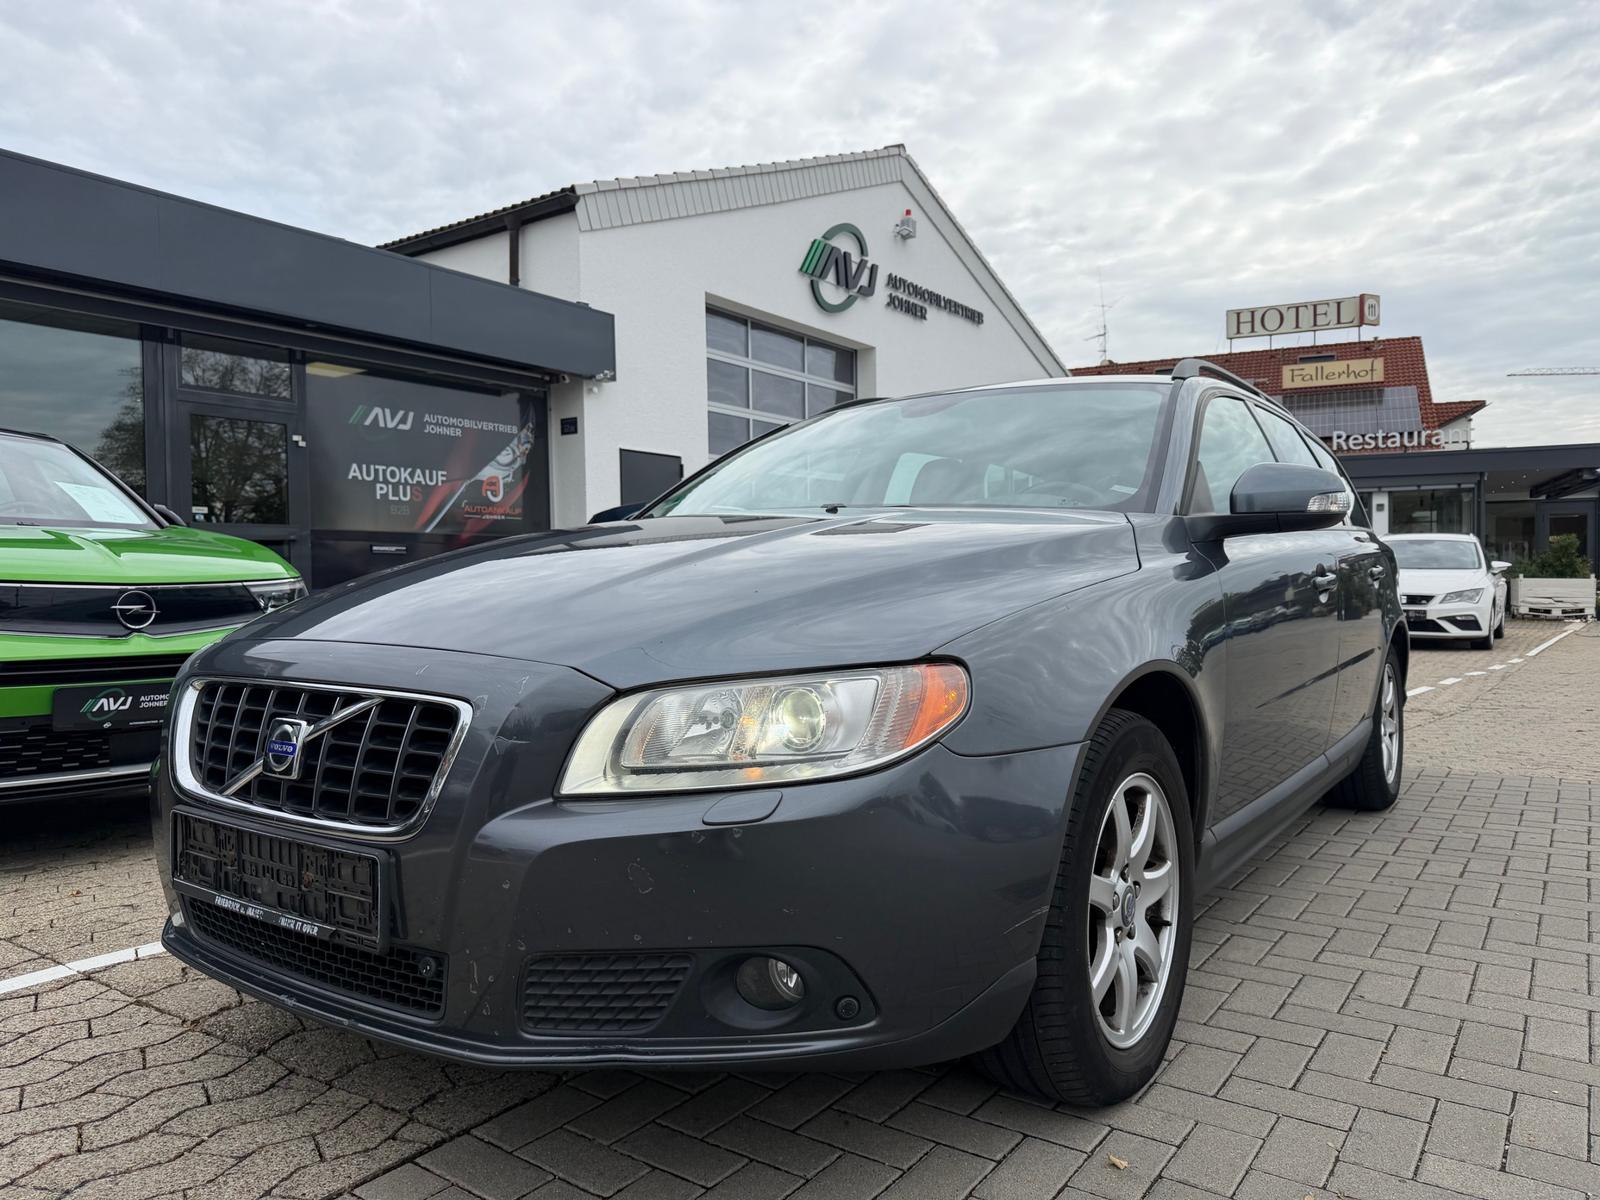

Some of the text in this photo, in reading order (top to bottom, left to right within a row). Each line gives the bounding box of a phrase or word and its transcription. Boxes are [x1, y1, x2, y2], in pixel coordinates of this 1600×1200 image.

[820, 246, 879, 297] AVJ
[885, 272, 984, 326] AUTOMOBILVERTRIEB
[886, 293, 928, 321] JOHNER
[1233, 300, 1356, 335] HOTEL
[1289, 359, 1378, 383] Fallerhof
[364, 407, 414, 430] AVJ
[424, 413, 518, 434] AUTOMOBILVERTRIEB
[424, 424, 462, 437] JOHNER
[348, 463, 447, 486] AUTOKAUF
[375, 483, 423, 502] PLUS
[92, 696, 133, 712] AVJ
[139, 693, 170, 702] AUTOMO
[270, 743, 294, 753] VOLVO
